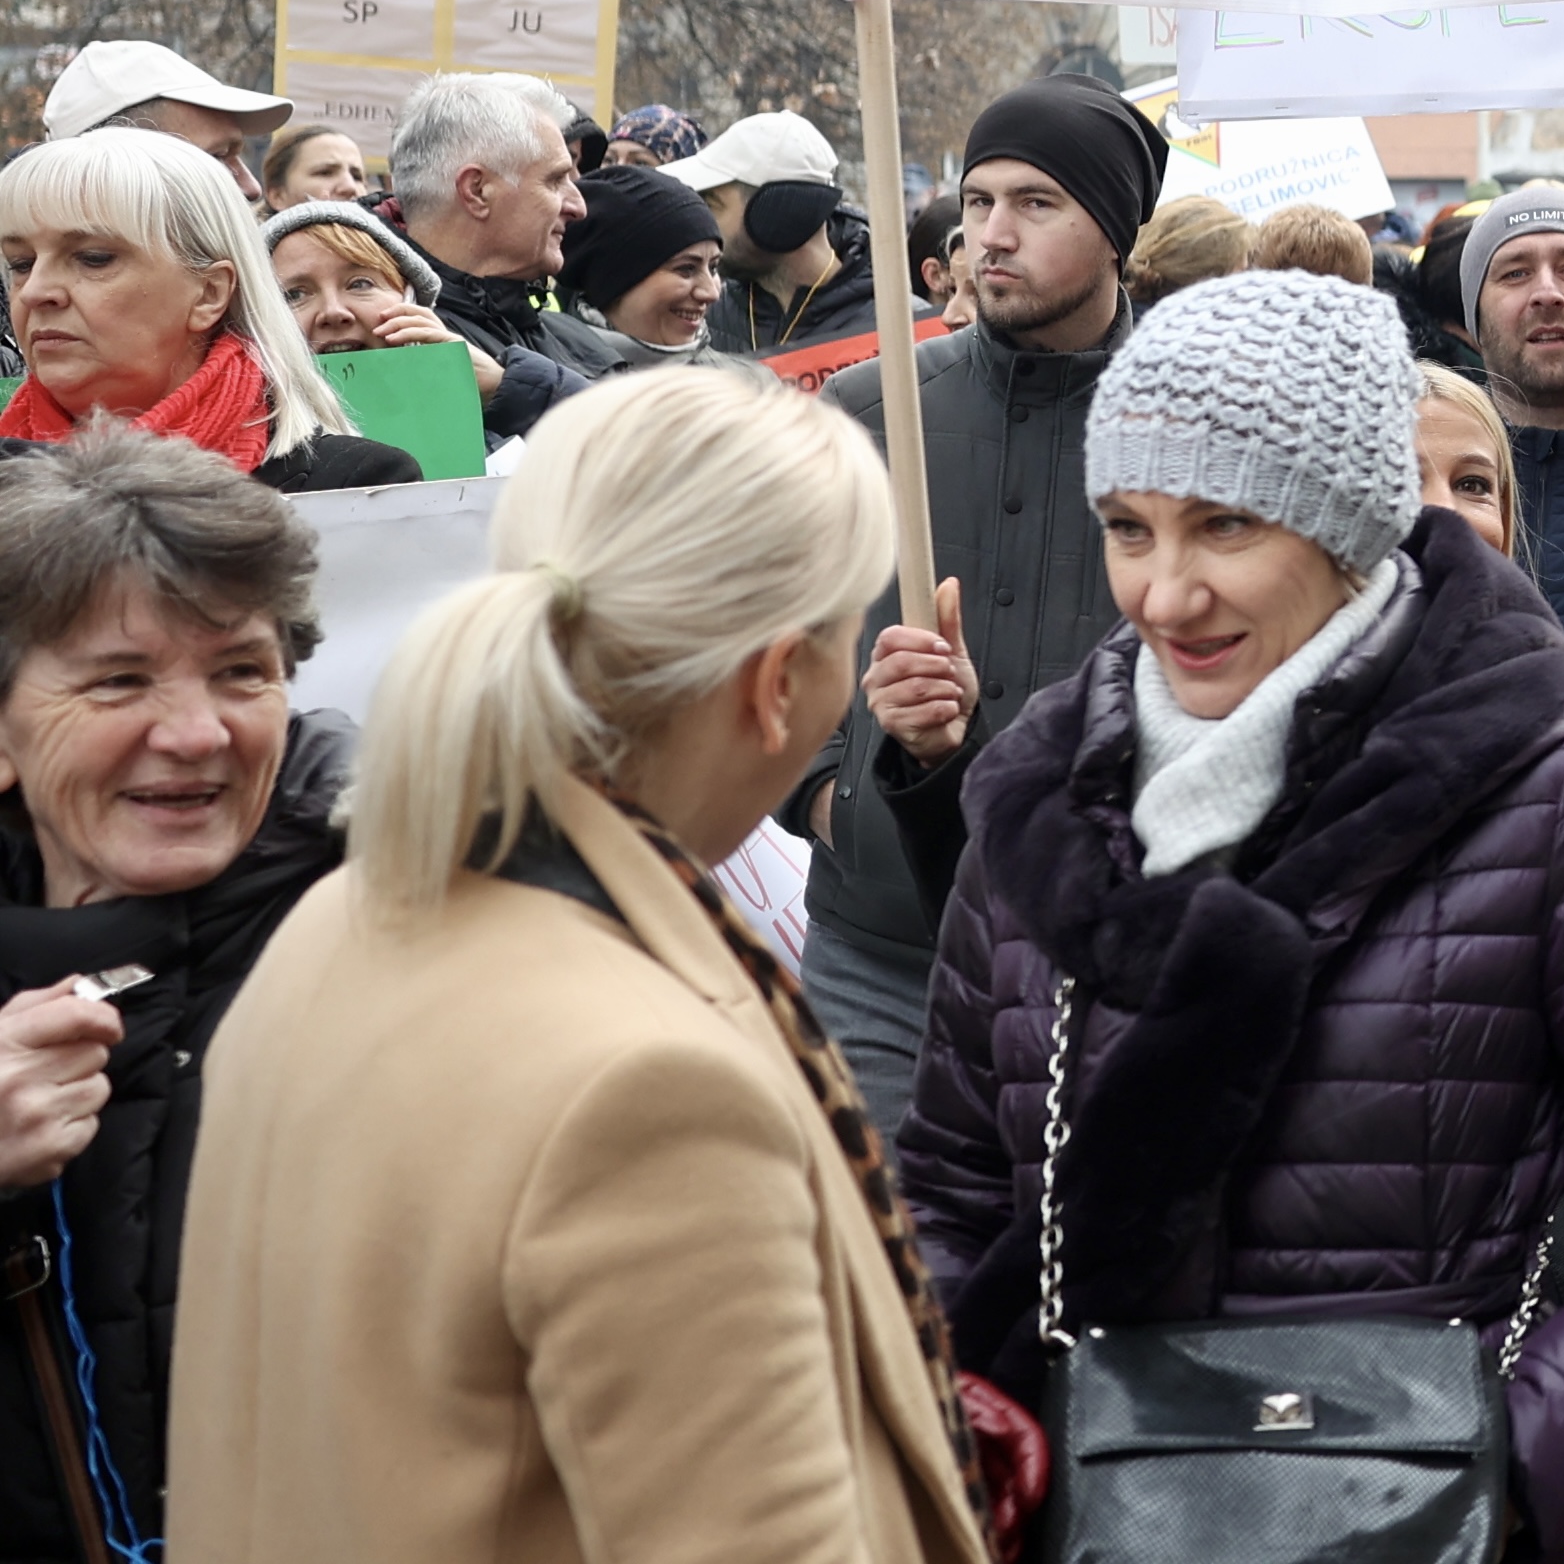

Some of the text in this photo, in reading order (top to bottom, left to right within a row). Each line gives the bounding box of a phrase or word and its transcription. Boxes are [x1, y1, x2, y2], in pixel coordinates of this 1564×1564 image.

[342, 0, 378, 24] SP
[508, 9, 542, 35] JU
[1509, 213, 1529, 225] NO
